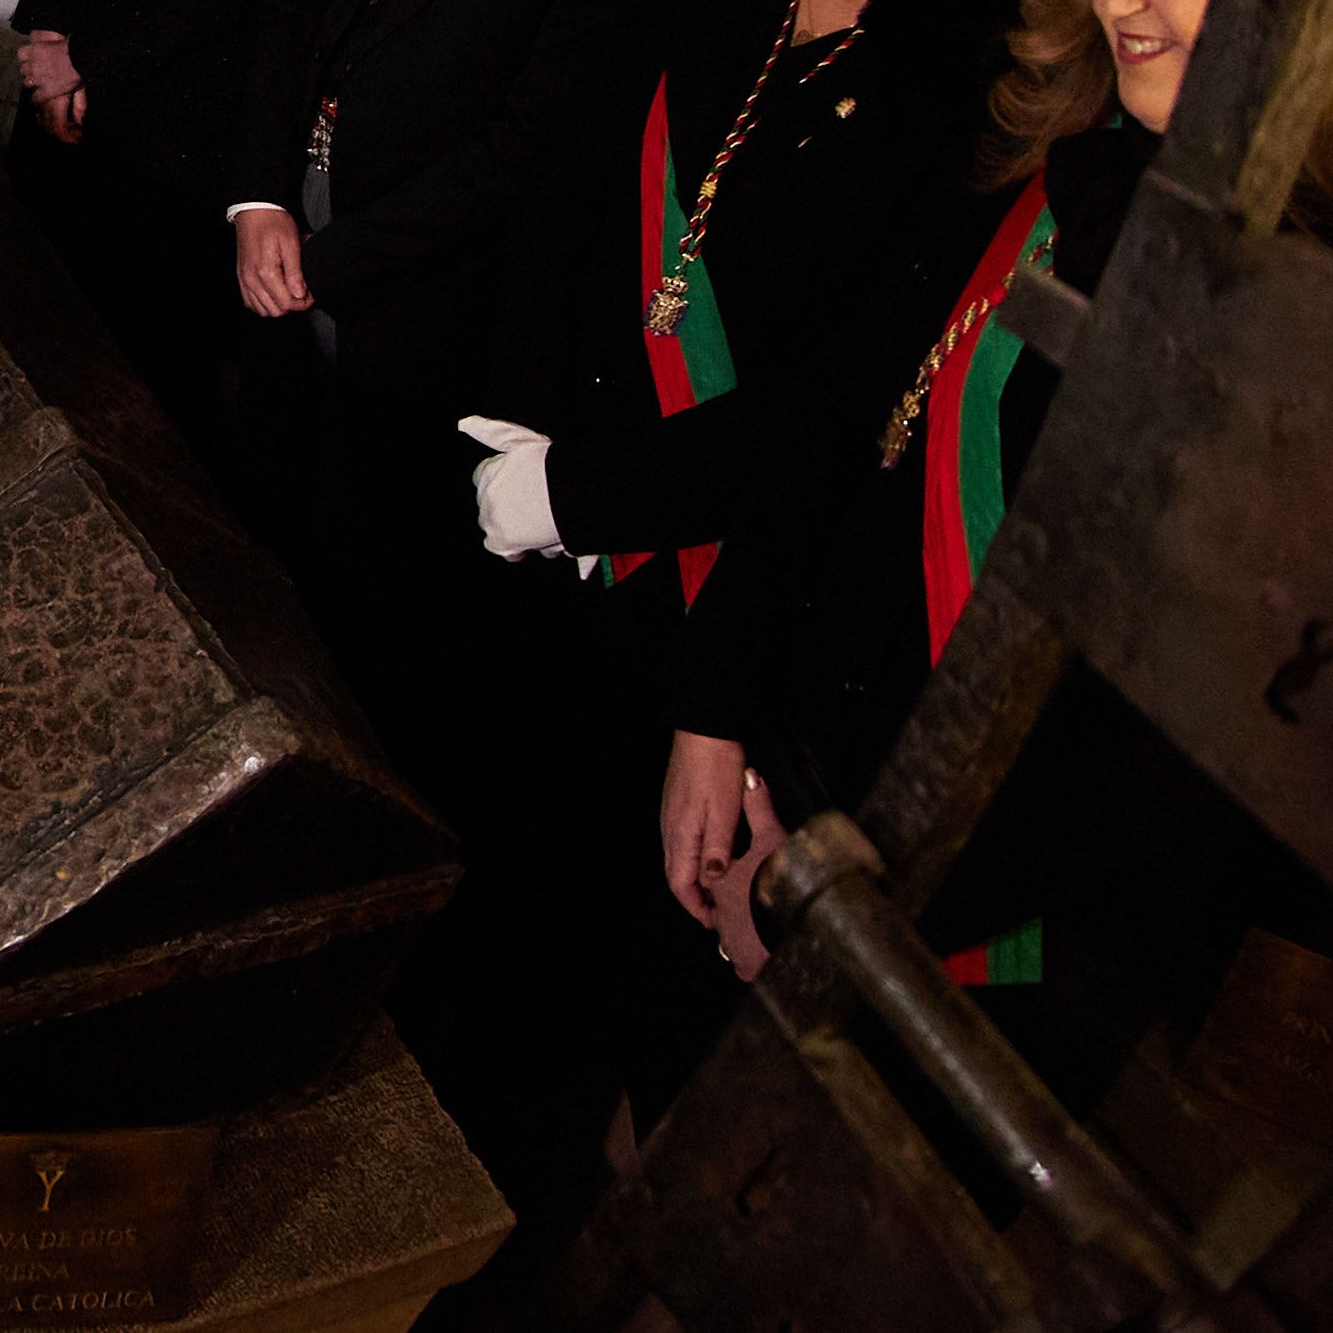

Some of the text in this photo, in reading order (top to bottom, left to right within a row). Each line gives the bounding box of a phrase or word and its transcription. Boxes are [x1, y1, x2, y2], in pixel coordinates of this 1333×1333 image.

[37, 1168, 65, 1213] Y
[37, 1230, 70, 1250] DE
[80, 1227, 137, 1247] DIOS
[32, 1290, 156, 1312] CATOLICA
